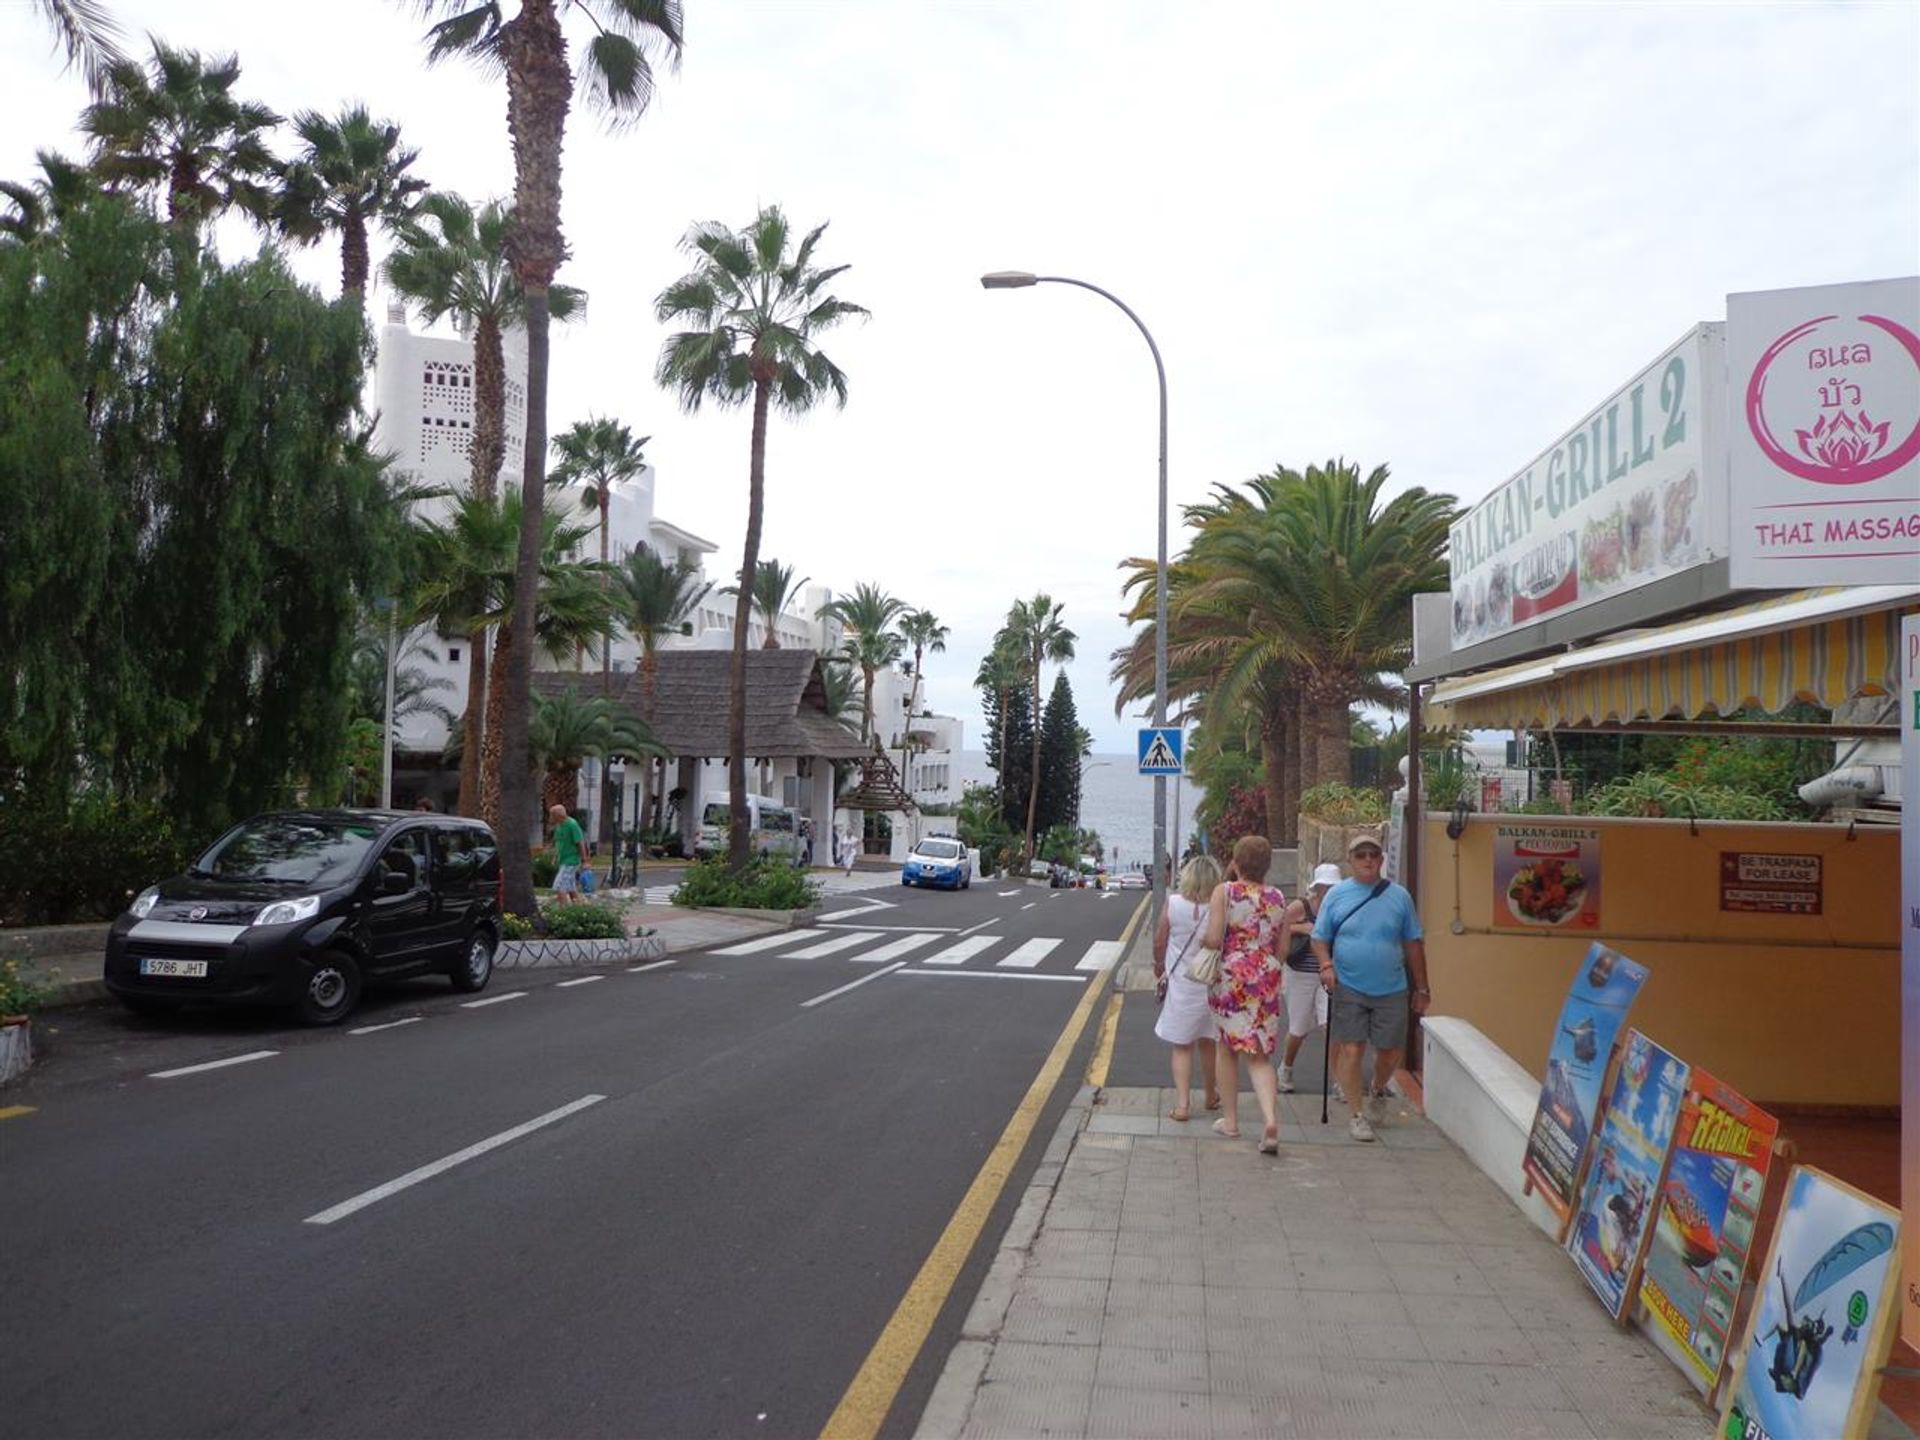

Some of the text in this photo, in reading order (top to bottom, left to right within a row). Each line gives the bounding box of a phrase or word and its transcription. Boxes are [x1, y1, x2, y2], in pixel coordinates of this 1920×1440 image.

[1452, 356, 1686, 580] BALKAN-GRILL 2
[1755, 522, 1814, 546] THAI
[1759, 857, 1817, 868] TRASPASA
[1745, 868, 1812, 880] FOR LEASE
[150, 961, 205, 975] 5786 JHT
[1666, 1308, 1691, 1339] HERE
